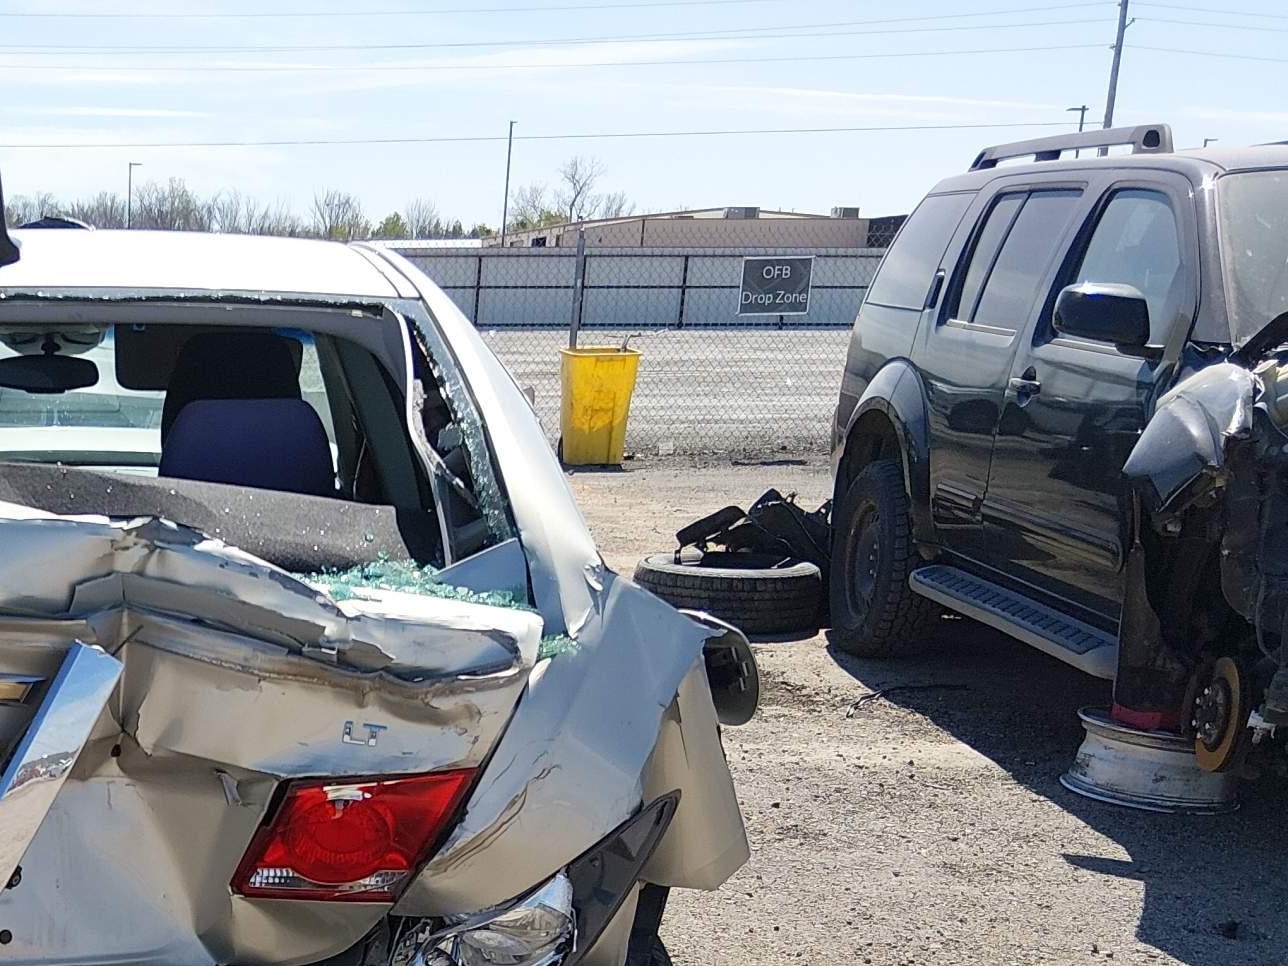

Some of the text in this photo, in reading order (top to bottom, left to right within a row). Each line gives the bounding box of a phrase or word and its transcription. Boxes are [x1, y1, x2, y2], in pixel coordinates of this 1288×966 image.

[762, 265, 791, 279] OFB
[741, 290, 808, 306] Drop Zone
[342, 720, 388, 747] LT
